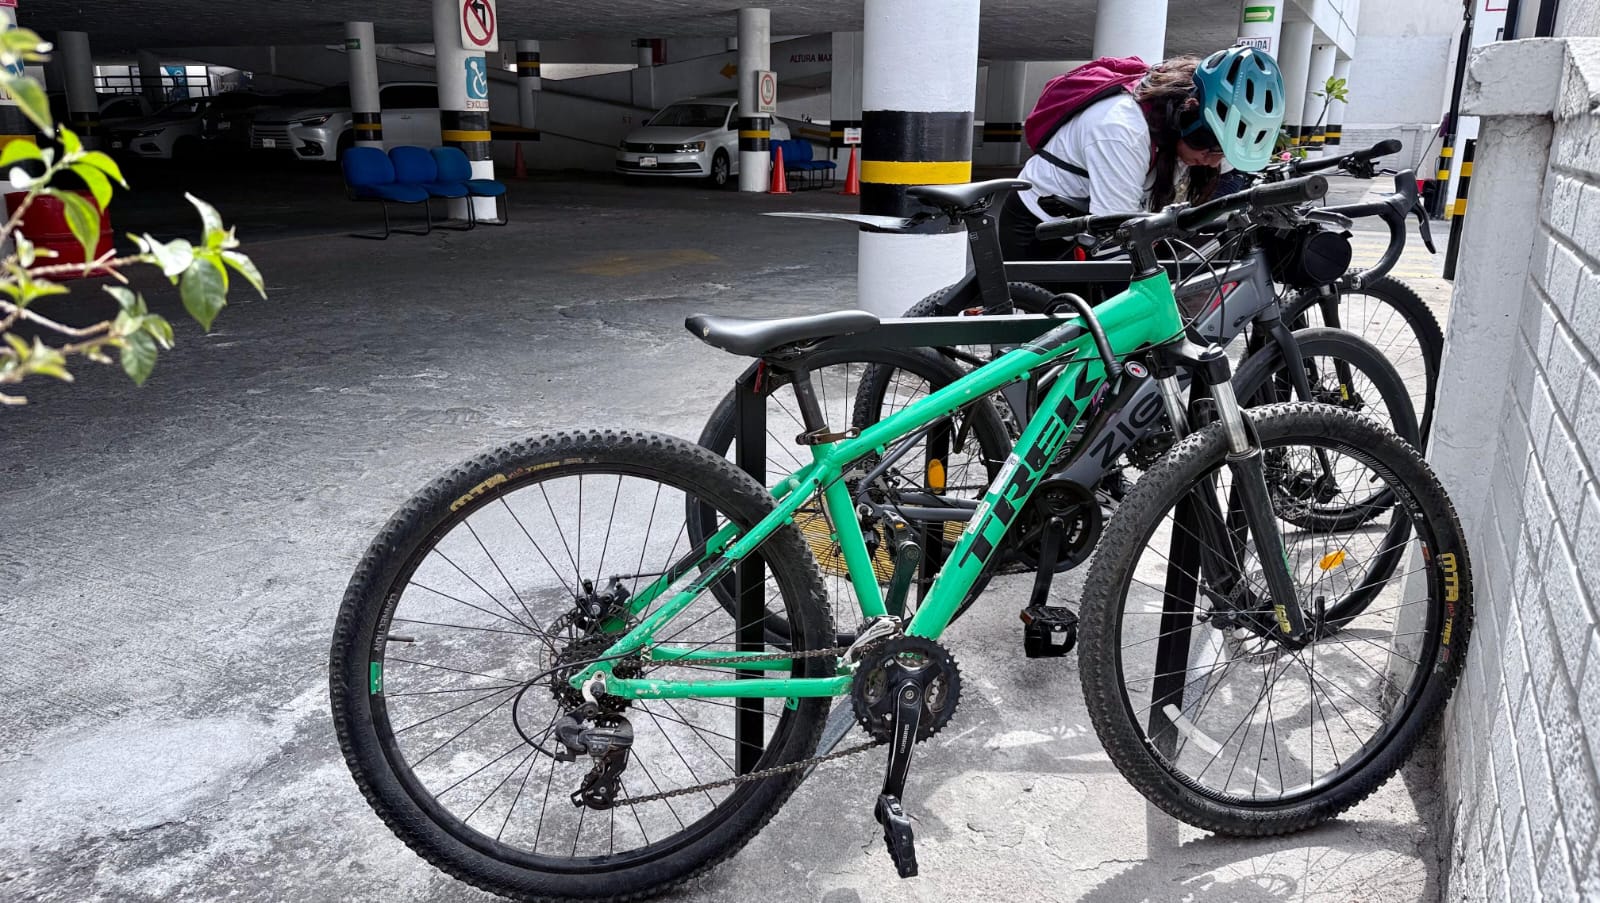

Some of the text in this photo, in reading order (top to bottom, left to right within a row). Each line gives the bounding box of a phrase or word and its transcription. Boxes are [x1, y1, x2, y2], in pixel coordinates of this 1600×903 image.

[790, 53, 816, 63] ALTURA
[1240, 39, 1268, 50] SALIDA
[958, 361, 1104, 569] TREK
[374, 593, 399, 652] CONNECTION
